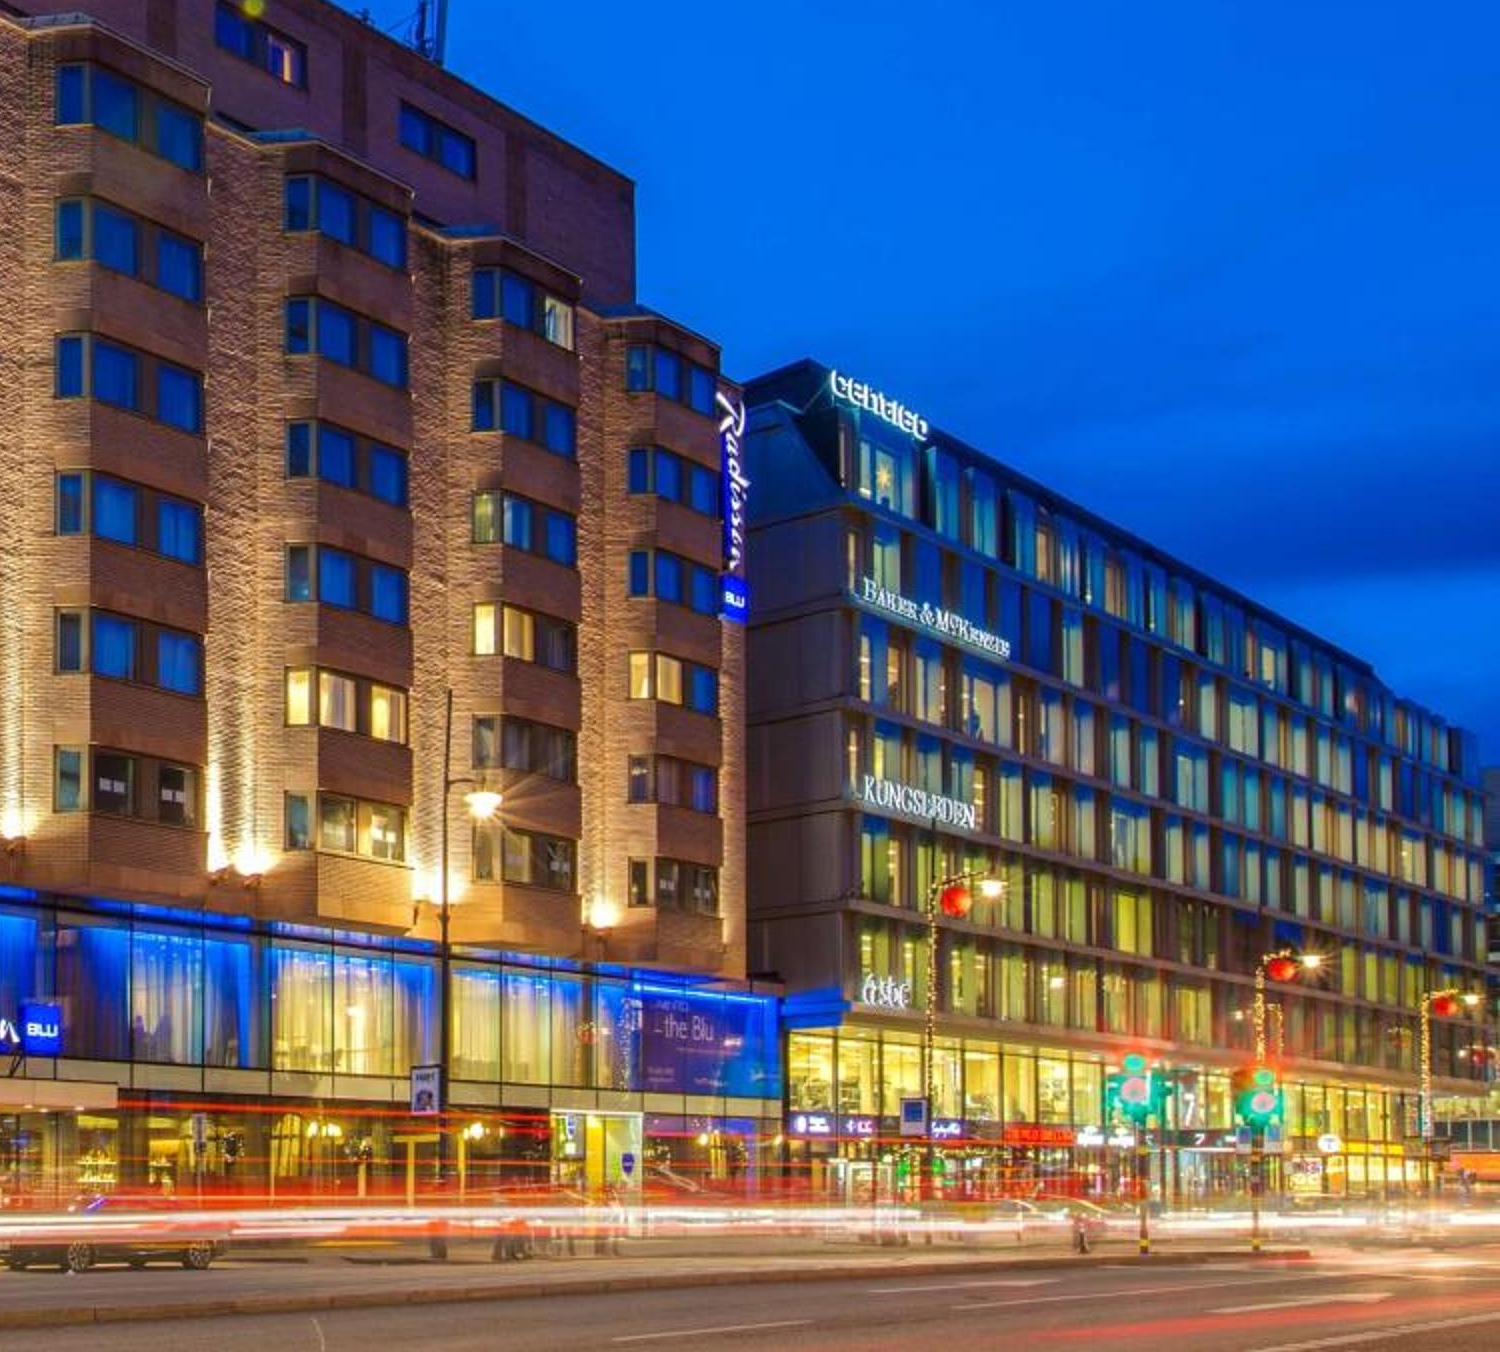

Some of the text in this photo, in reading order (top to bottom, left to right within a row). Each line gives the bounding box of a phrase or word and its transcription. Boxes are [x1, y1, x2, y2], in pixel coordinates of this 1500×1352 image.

[715, 391, 751, 608] Radisson BLU
[919, 601, 936, 626] &
[863, 774, 976, 830] KUNGSLEDEN
[27, 1022, 58, 1036] BLU
[691, 1015, 715, 1041] Blu
